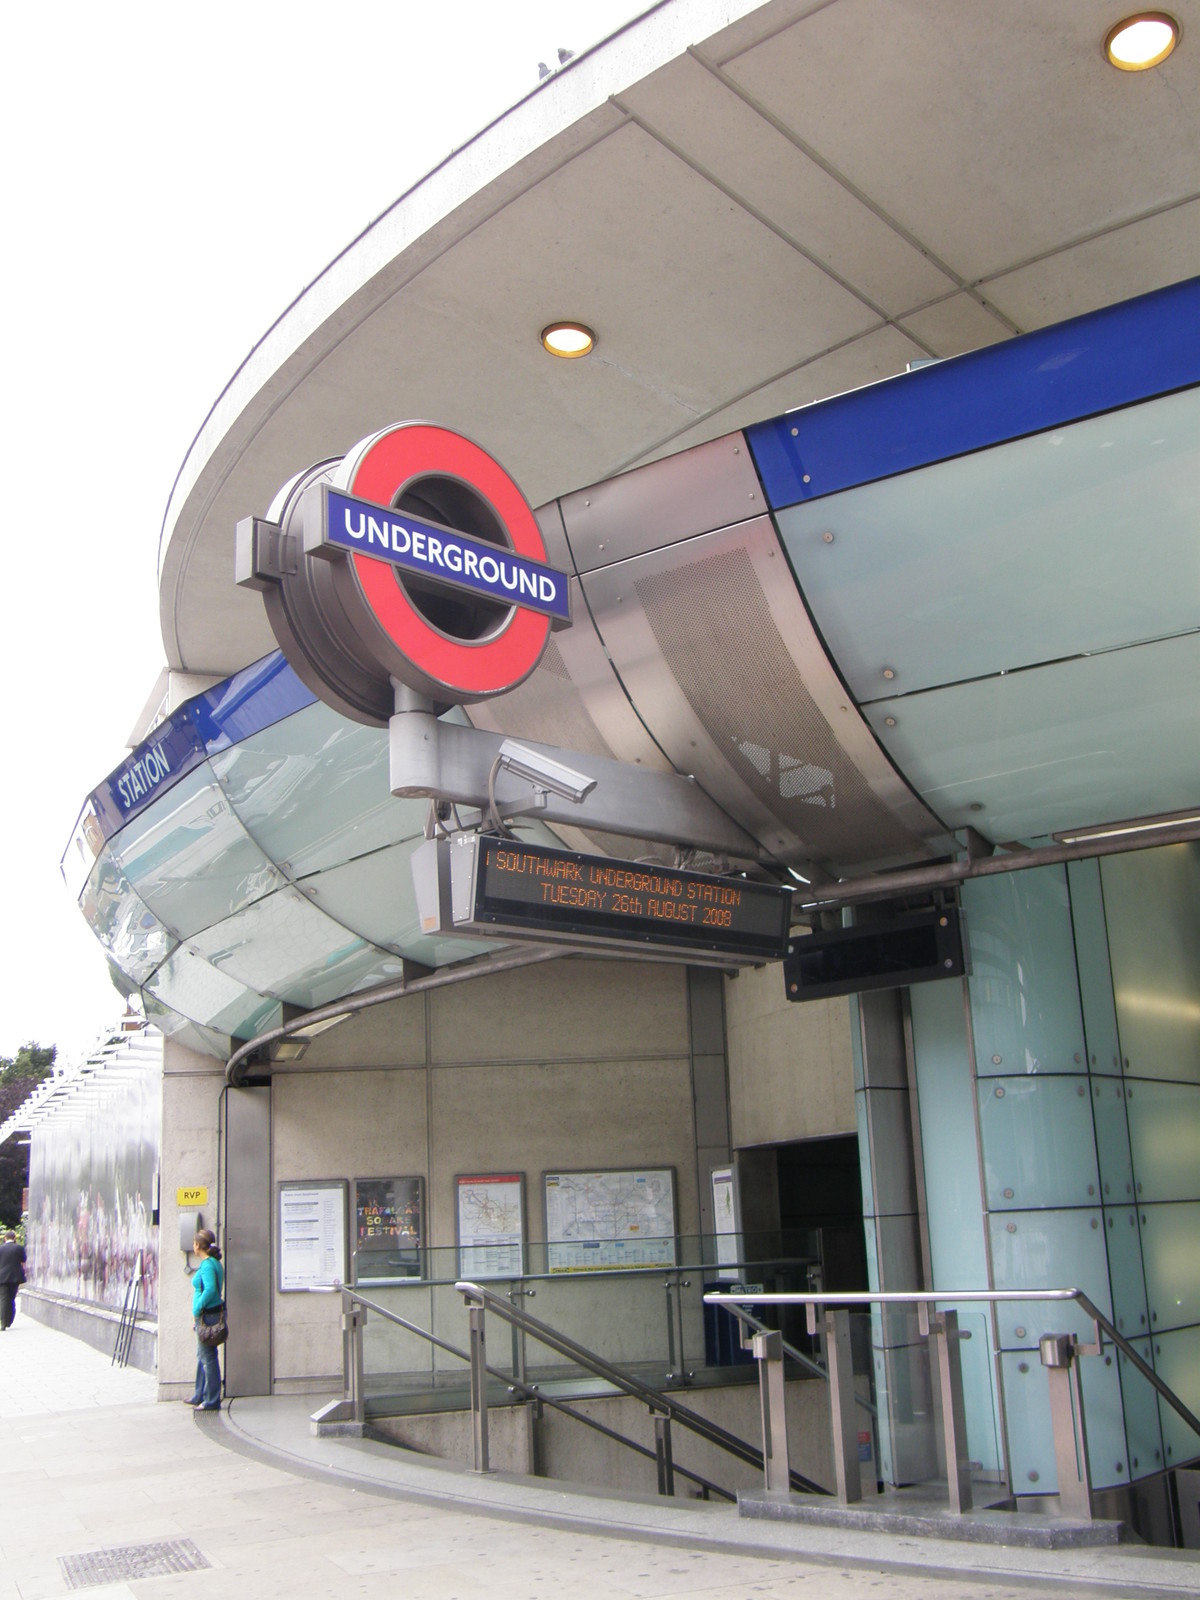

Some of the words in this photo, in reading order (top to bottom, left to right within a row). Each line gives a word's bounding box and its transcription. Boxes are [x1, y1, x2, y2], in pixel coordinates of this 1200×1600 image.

[344, 508, 556, 602] UNDERGROUND
[117, 743, 171, 808] STATION
[495, 851, 584, 882] SOUTHWARK
[589, 865, 683, 897] UNDERGROUND
[687, 882, 741, 906] STATION
[540, 882, 607, 908] TUESDAY
[611, 893, 643, 915] 26th
[647, 899, 699, 922] AUGUST
[702, 907, 732, 926] 2008
[183, 1191, 201, 1199] RVP
